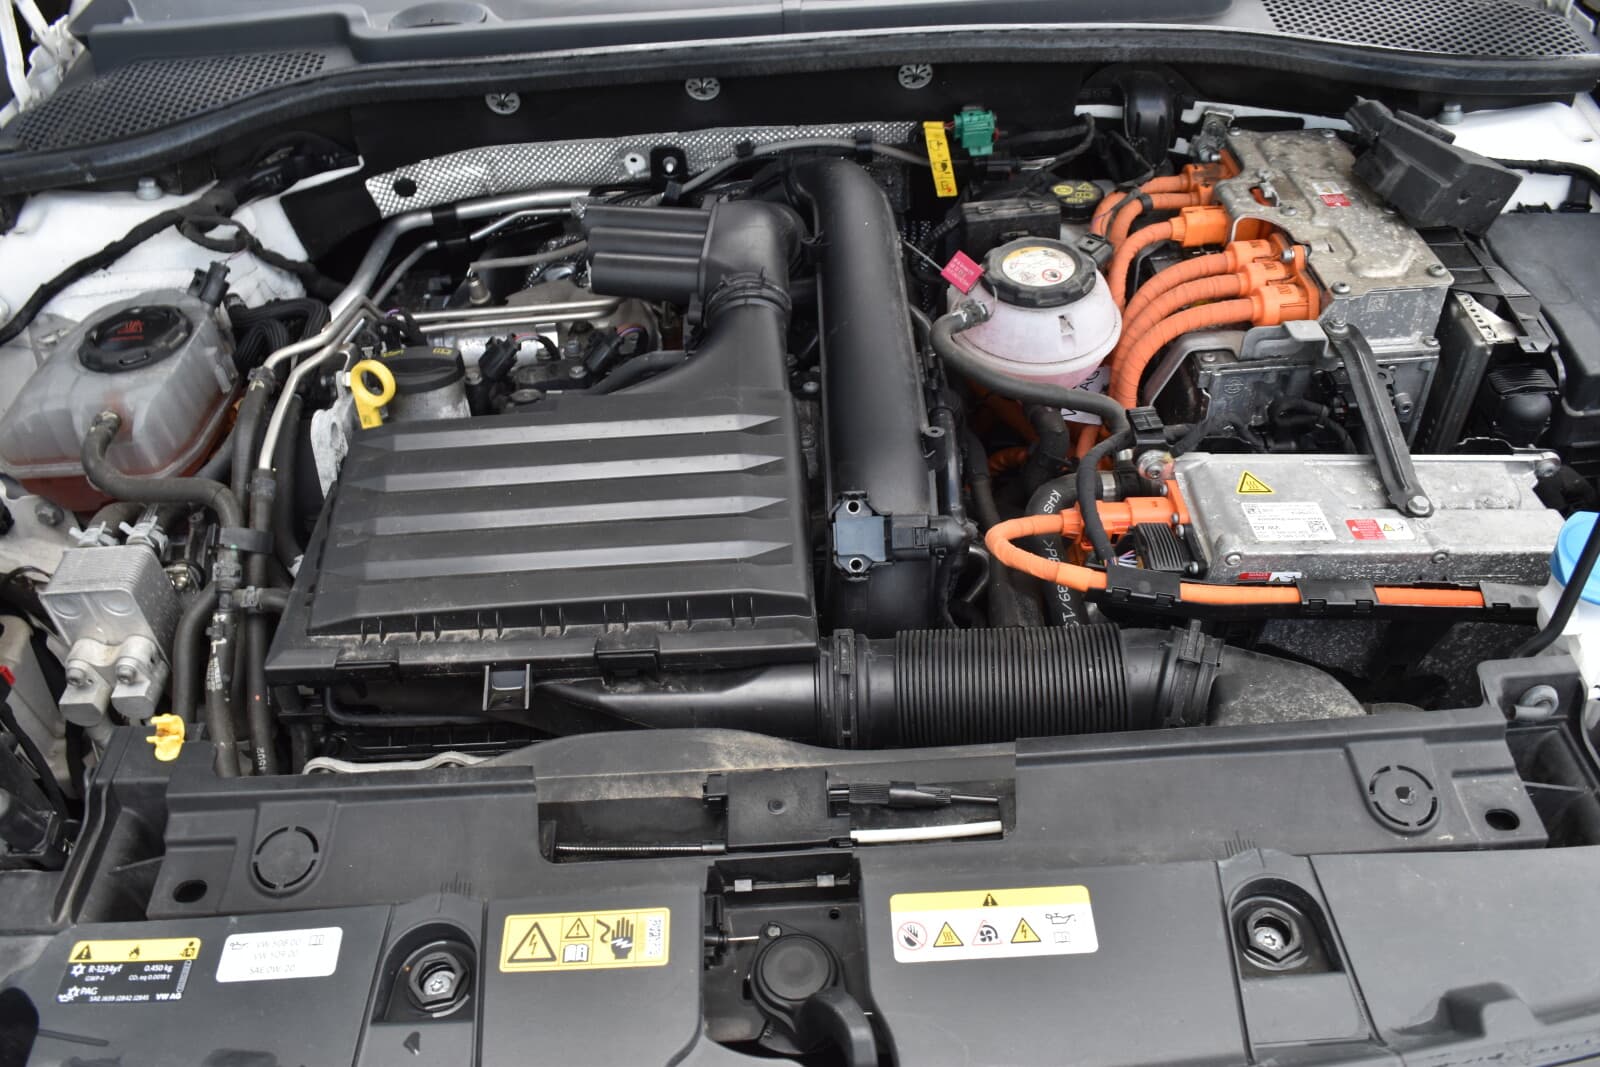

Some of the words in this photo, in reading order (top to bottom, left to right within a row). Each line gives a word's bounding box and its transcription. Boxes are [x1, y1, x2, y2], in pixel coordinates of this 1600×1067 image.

[88, 963, 123, 975] R-1234yf
[164, 963, 174, 973] kg
[80, 986, 99, 995] PAG
[155, 992, 169, 1000] VW
[169, 992, 182, 1000] AG
